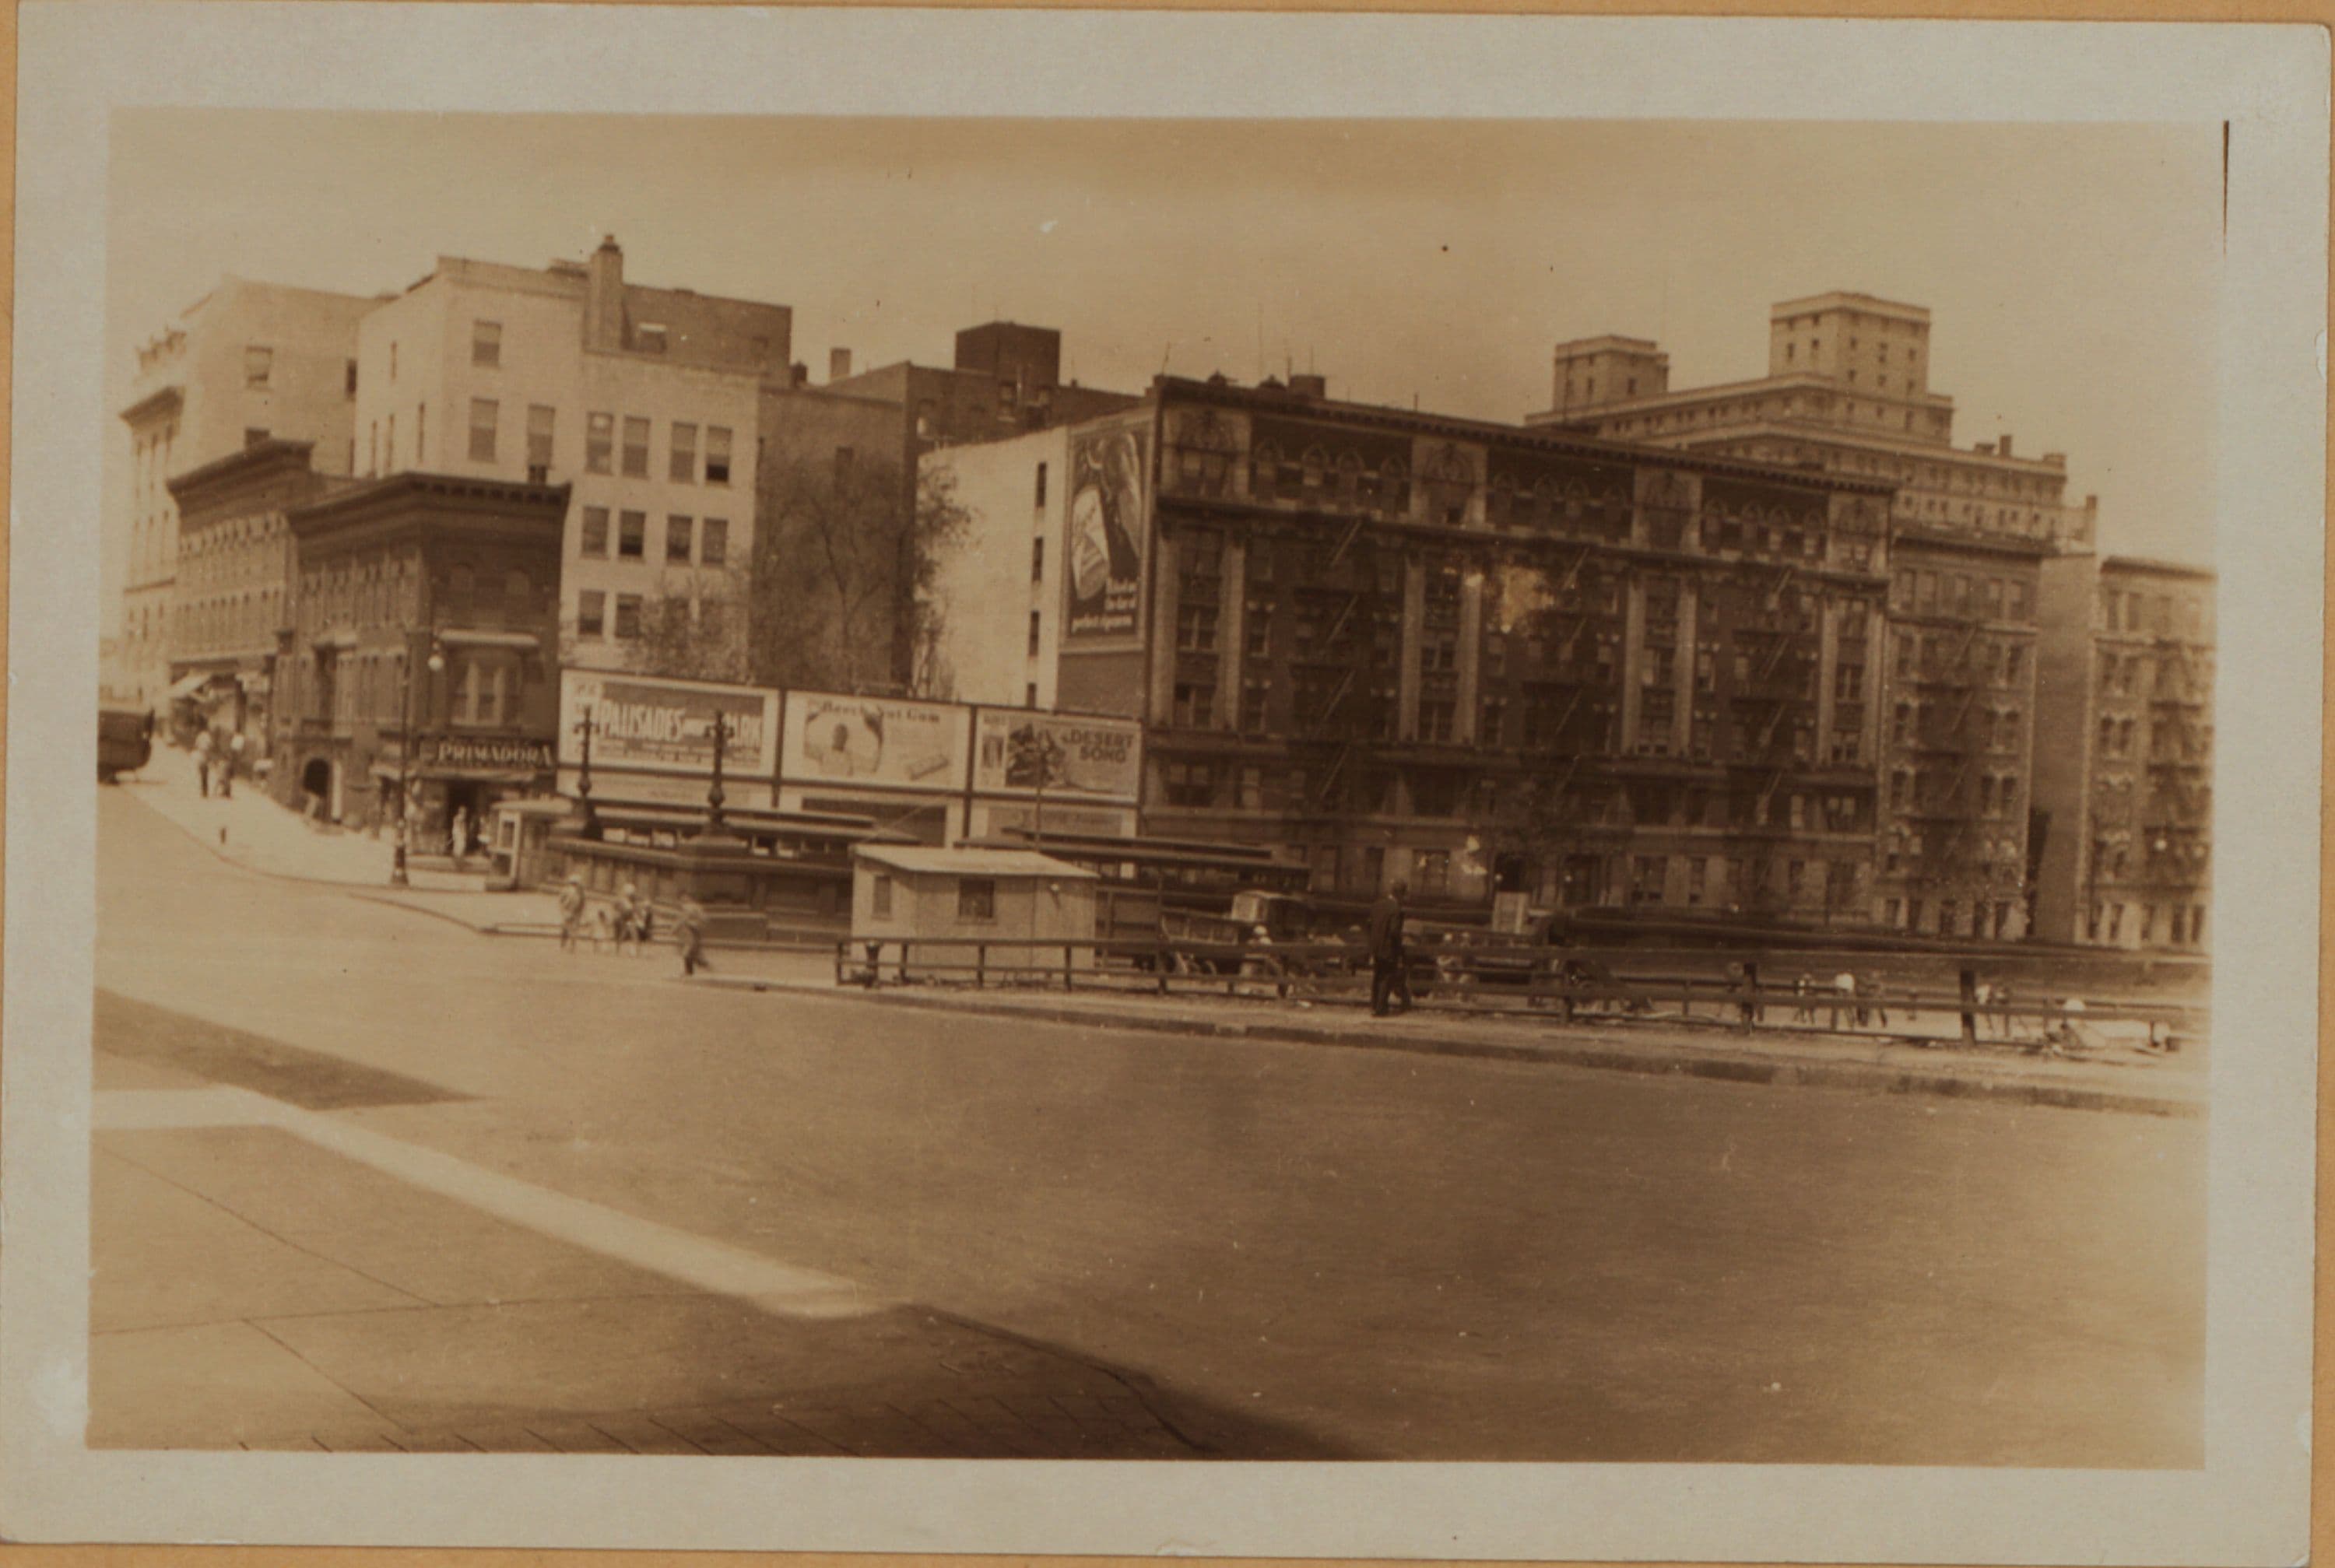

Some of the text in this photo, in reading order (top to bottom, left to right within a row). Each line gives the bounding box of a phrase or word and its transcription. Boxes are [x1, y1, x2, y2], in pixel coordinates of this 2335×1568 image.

[599, 699, 686, 742] PALISADES
[1070, 728, 1134, 748] DESERT
[437, 742, 553, 766] PRIMADORA
[1080, 745, 1126, 764] SONG
